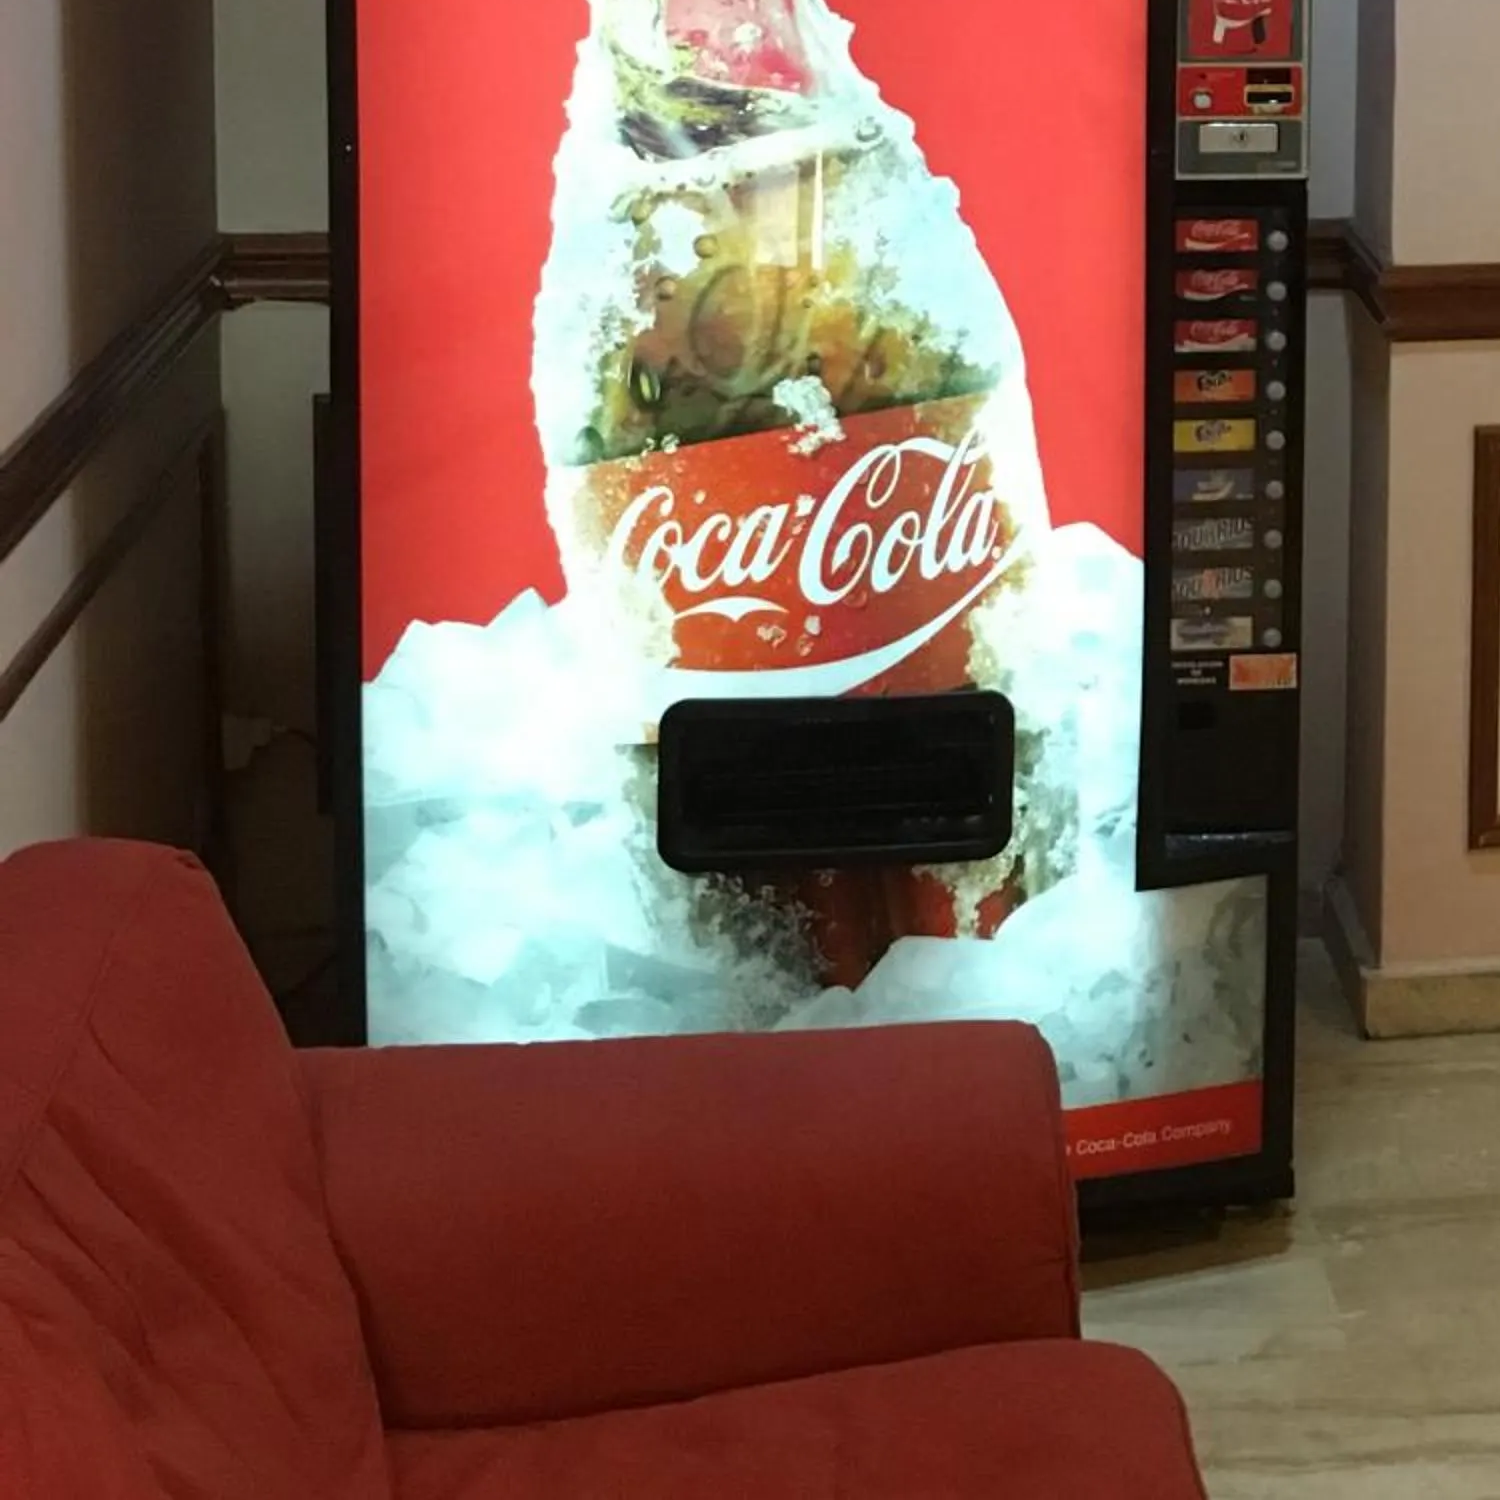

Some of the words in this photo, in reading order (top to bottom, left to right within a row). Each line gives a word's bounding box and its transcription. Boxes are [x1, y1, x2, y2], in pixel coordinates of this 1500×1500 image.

[607, 429, 1001, 606] Coca-Cola
[1076, 1130, 1157, 1156] Coca-Cola
[1161, 1117, 1232, 1142] Company
